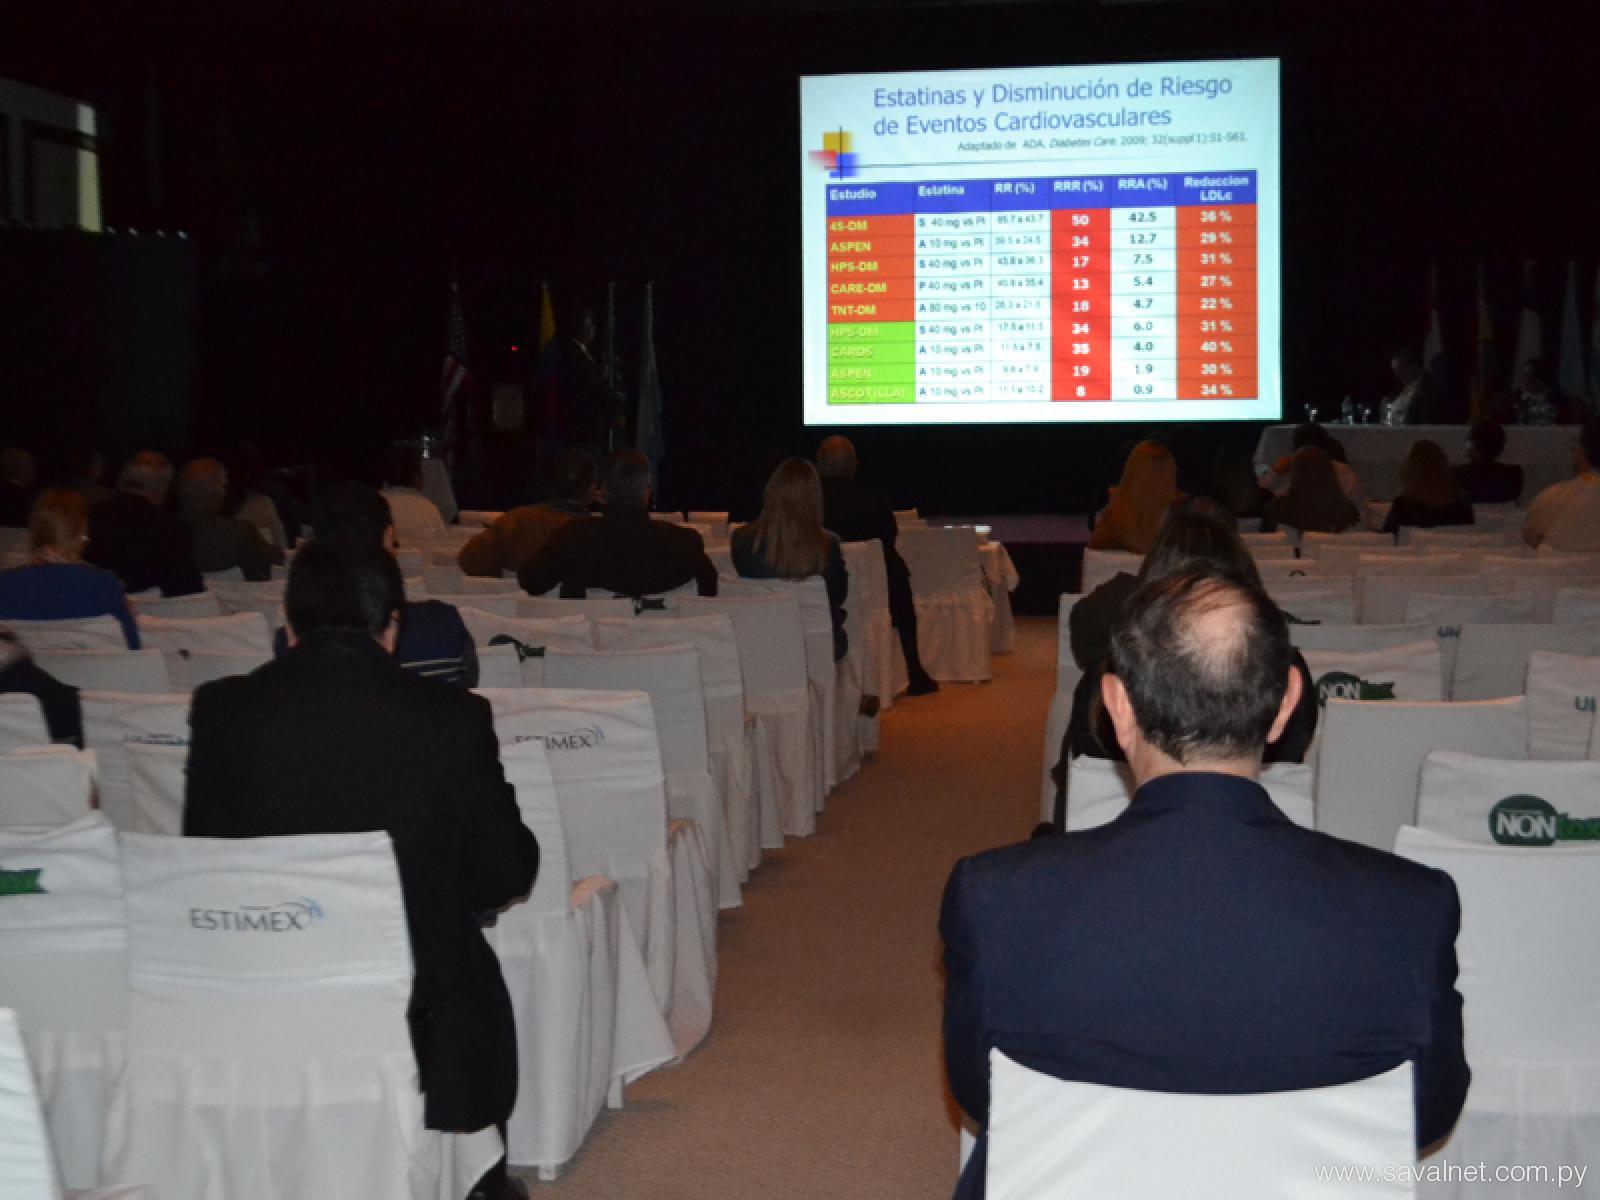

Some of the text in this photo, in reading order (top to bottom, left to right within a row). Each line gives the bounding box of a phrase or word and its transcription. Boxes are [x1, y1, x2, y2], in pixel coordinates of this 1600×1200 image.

[874, 75, 1233, 108] Estatinas y Disminución de Riesgo
[874, 107, 1172, 137] de Eventos Cardiovasculares
[829, 176, 1249, 201] Estudio Estatina RR (%) RRR (%) RRA (%) Reduccion
[1200, 190, 1232, 201] LDLc
[945, 219, 959, 228] mg
[1128, 212, 1157, 223] 42.5
[1219, 211, 1233, 222] %
[830, 241, 871, 252] ASPEN
[919, 240, 926, 248] A
[943, 240, 958, 249] mg
[1072, 235, 1090, 248] 34
[1129, 233, 1157, 244] 12.7
[1219, 232, 1233, 244] %
[830, 261, 878, 272] HPS-DM
[943, 260, 958, 270] mg
[1072, 256, 1090, 268] 17
[1133, 254, 1153, 264] 7.5
[1200, 252, 1217, 264] 31
[1219, 252, 1233, 264] %
[830, 282, 887, 294] CARE-DM
[943, 282, 958, 292] mg
[1072, 278, 1090, 290] 13
[1133, 276, 1153, 286] 5.4
[1219, 275, 1233, 287] %
[831, 304, 876, 315] TNT-DM
[919, 304, 926, 312] A
[943, 304, 958, 314] mg
[1133, 298, 1153, 308] 4.7
[1219, 298, 1233, 310] %
[943, 326, 958, 336] mg
[1072, 323, 1090, 334] 34
[1133, 320, 1153, 331] 6.0
[1200, 320, 1217, 332] 31
[1219, 320, 1233, 332] %
[919, 346, 926, 354] A
[943, 346, 958, 356] mg
[1133, 341, 1153, 352] 4.0
[1219, 341, 1233, 353] %
[919, 367, 926, 376] A
[943, 368, 958, 378] mg
[1072, 365, 1090, 377] 19
[1135, 363, 1153, 374] 1.9
[1219, 363, 1233, 375] %
[943, 388, 958, 397] mg
[1219, 384, 1233, 396] %
[1497, 812, 1557, 839] NON
[190, 906, 304, 932] ESTIMEX
